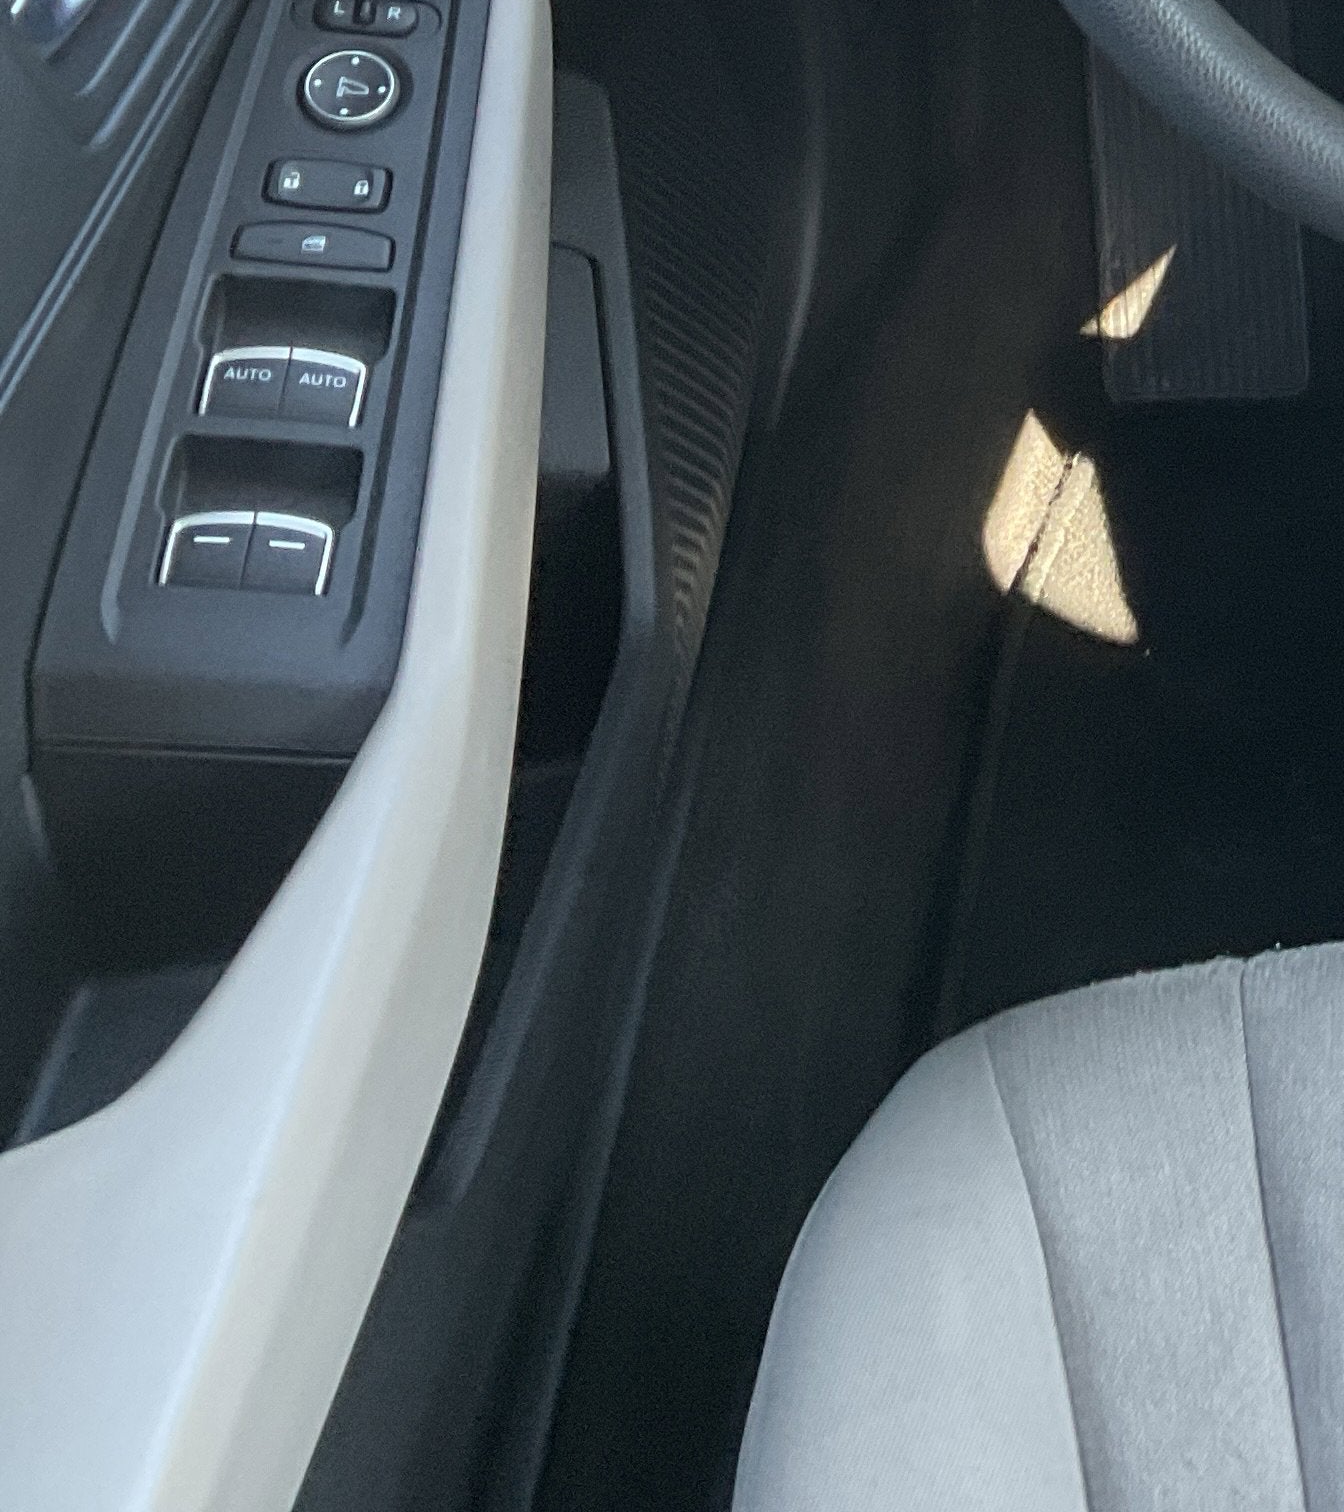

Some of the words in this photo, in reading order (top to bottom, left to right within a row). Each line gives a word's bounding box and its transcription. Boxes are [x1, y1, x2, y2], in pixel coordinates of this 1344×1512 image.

[333, 0, 345, 16] L
[386, 6, 401, 20] R
[223, 366, 272, 382] AUTO
[299, 372, 347, 388] AUTO
